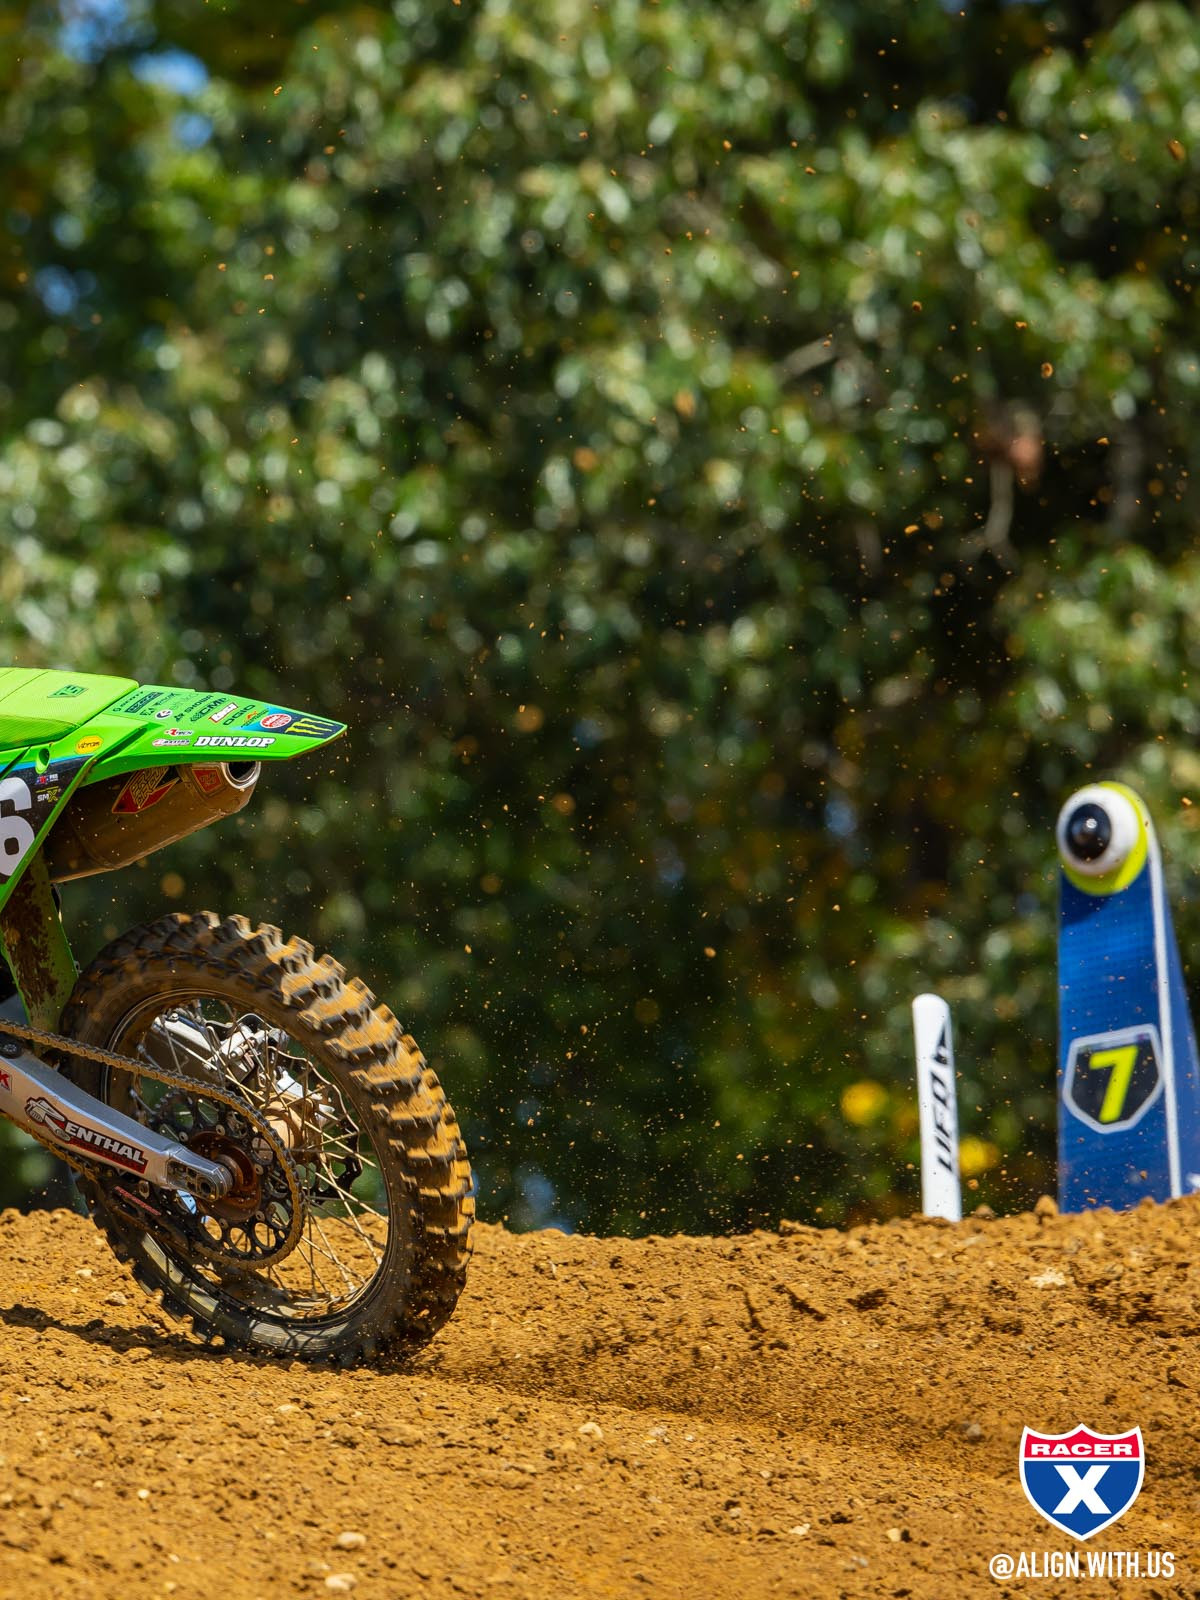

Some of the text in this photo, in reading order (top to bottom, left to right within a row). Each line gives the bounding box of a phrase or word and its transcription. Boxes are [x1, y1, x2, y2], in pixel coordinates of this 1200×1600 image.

[193, 736, 276, 748] DUNLOP
[1088, 1045, 1139, 1124] 7
[931, 1078, 955, 1173] UFO
